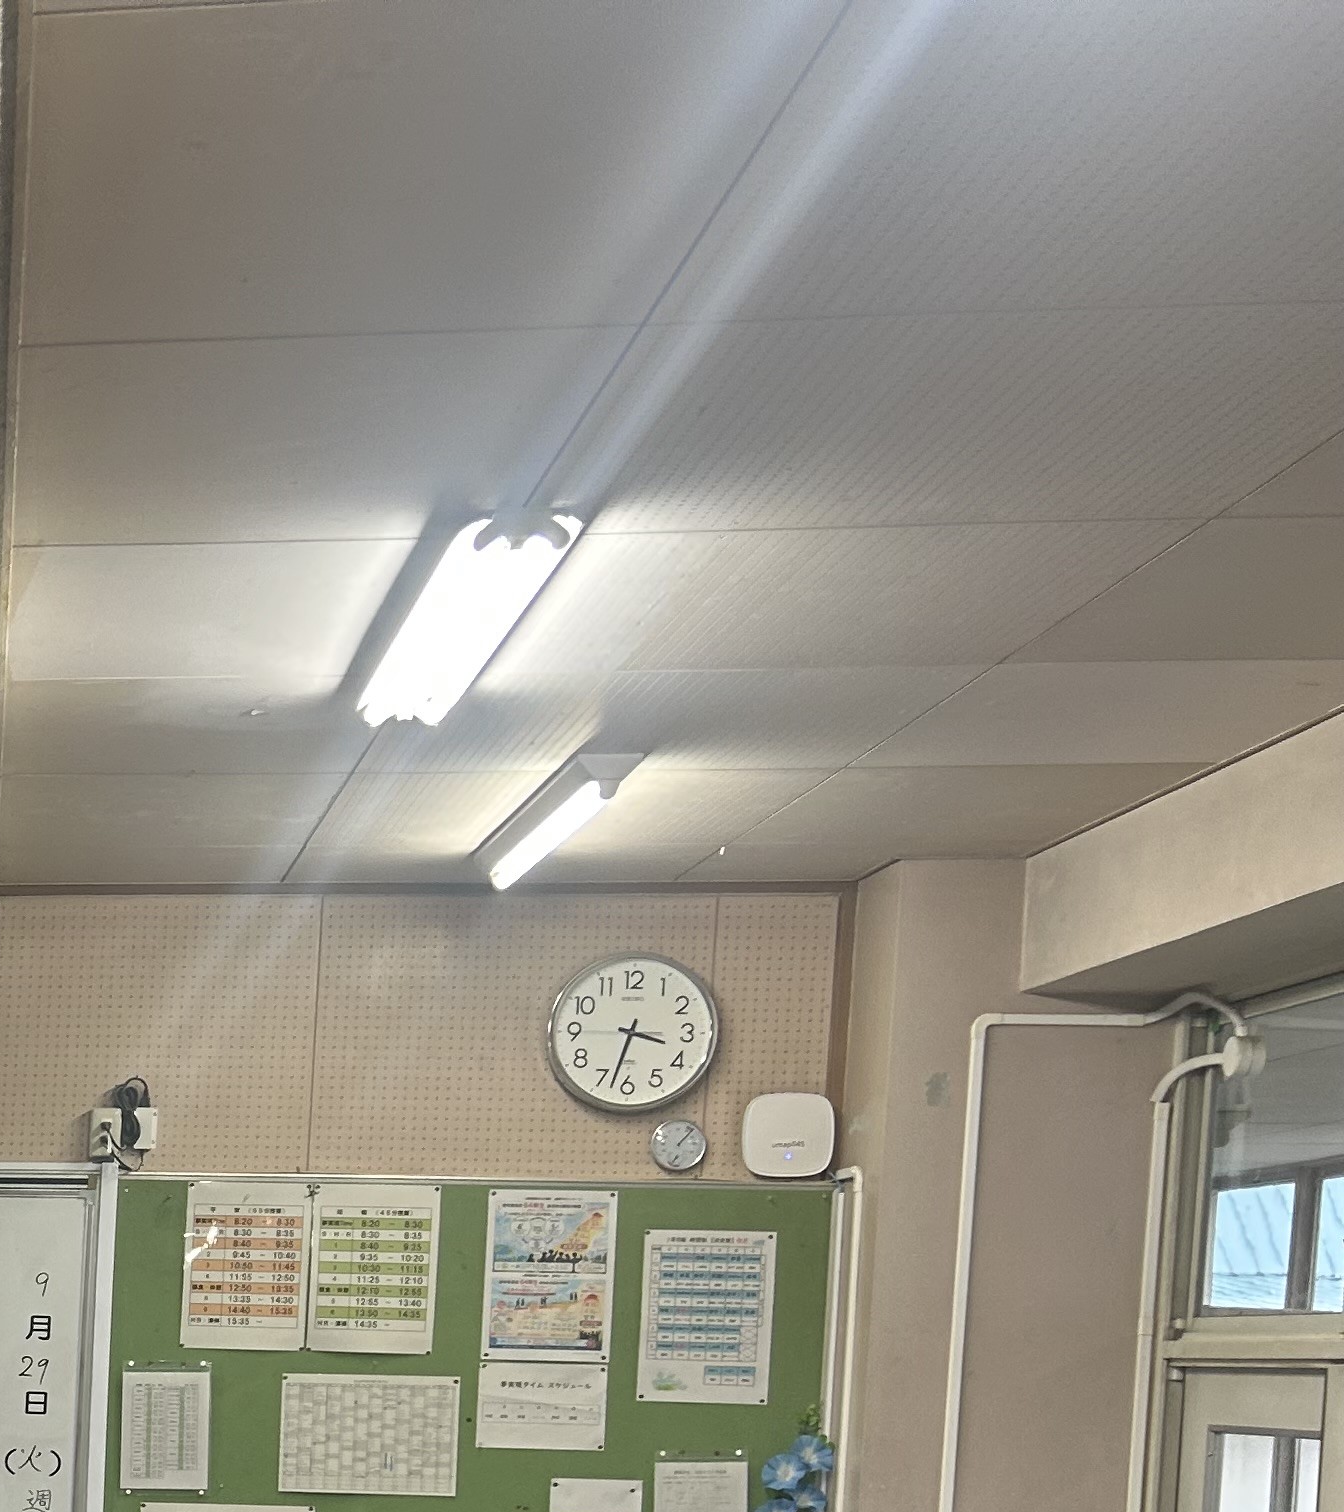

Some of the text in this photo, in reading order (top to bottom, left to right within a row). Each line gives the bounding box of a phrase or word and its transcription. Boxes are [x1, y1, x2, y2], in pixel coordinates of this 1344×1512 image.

[599, 976, 613, 997] 11
[624, 970, 645, 990] 12
[661, 977, 667, 996] 1
[574, 996, 596, 1016] 10
[675, 996, 690, 1015] 2
[567, 1022, 582, 1041] 9
[680, 1023, 695, 1043] 3
[573, 1048, 588, 1068] 8
[670, 1051, 684, 1070] 4
[595, 1069, 609, 1087] 7
[620, 1075, 635, 1095] 6
[649, 1069, 663, 1088] 5
[361, 1220, 380, 1228] 8:20
[404, 1220, 423, 1228] 8:30
[271, 1296, 294, 1304] 14:30
[399, 1299, 422, 1307] 13:40
